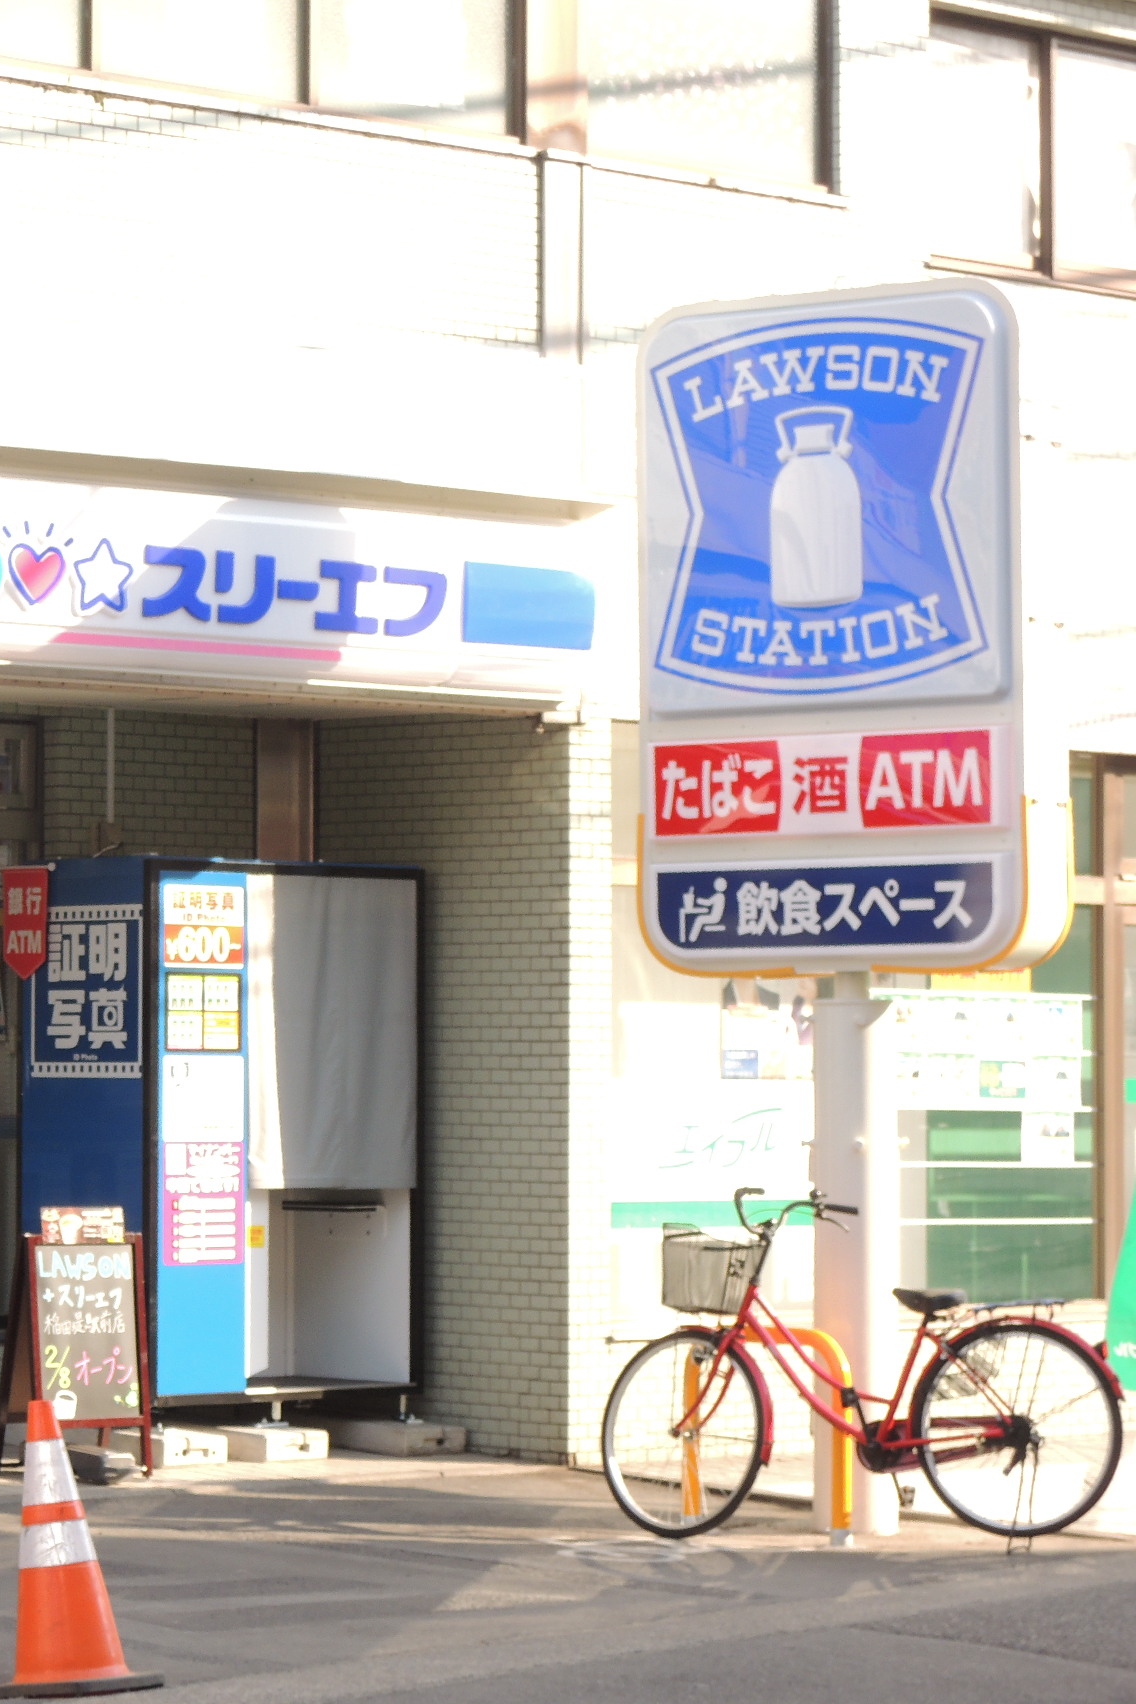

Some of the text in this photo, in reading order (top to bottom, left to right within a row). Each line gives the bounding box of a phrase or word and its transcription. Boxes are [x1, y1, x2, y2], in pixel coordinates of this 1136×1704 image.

[684, 344, 949, 422] LAWSON
[142, 544, 447, 637] スリーエフ
[691, 593, 948, 666] STATION
[661, 746, 983, 821] たばこ 酒 ATM
[7, 887, 42, 915] 銀行
[172, 891, 235, 911] 証明写真
[183, 914, 192, 922] ID
[737, 877, 973, 937] 飲食スペース
[6, 930, 43, 954] ATM
[47, 922, 128, 982] 証明
[47, 984, 128, 1049] 写真
[80, 1053, 98, 1061] Photo
[37, 1251, 132, 1281] LAWSON
[59, 1284, 123, 1309] スリーエフ
[45, 1345, 134, 1390] 2/8 オープン
